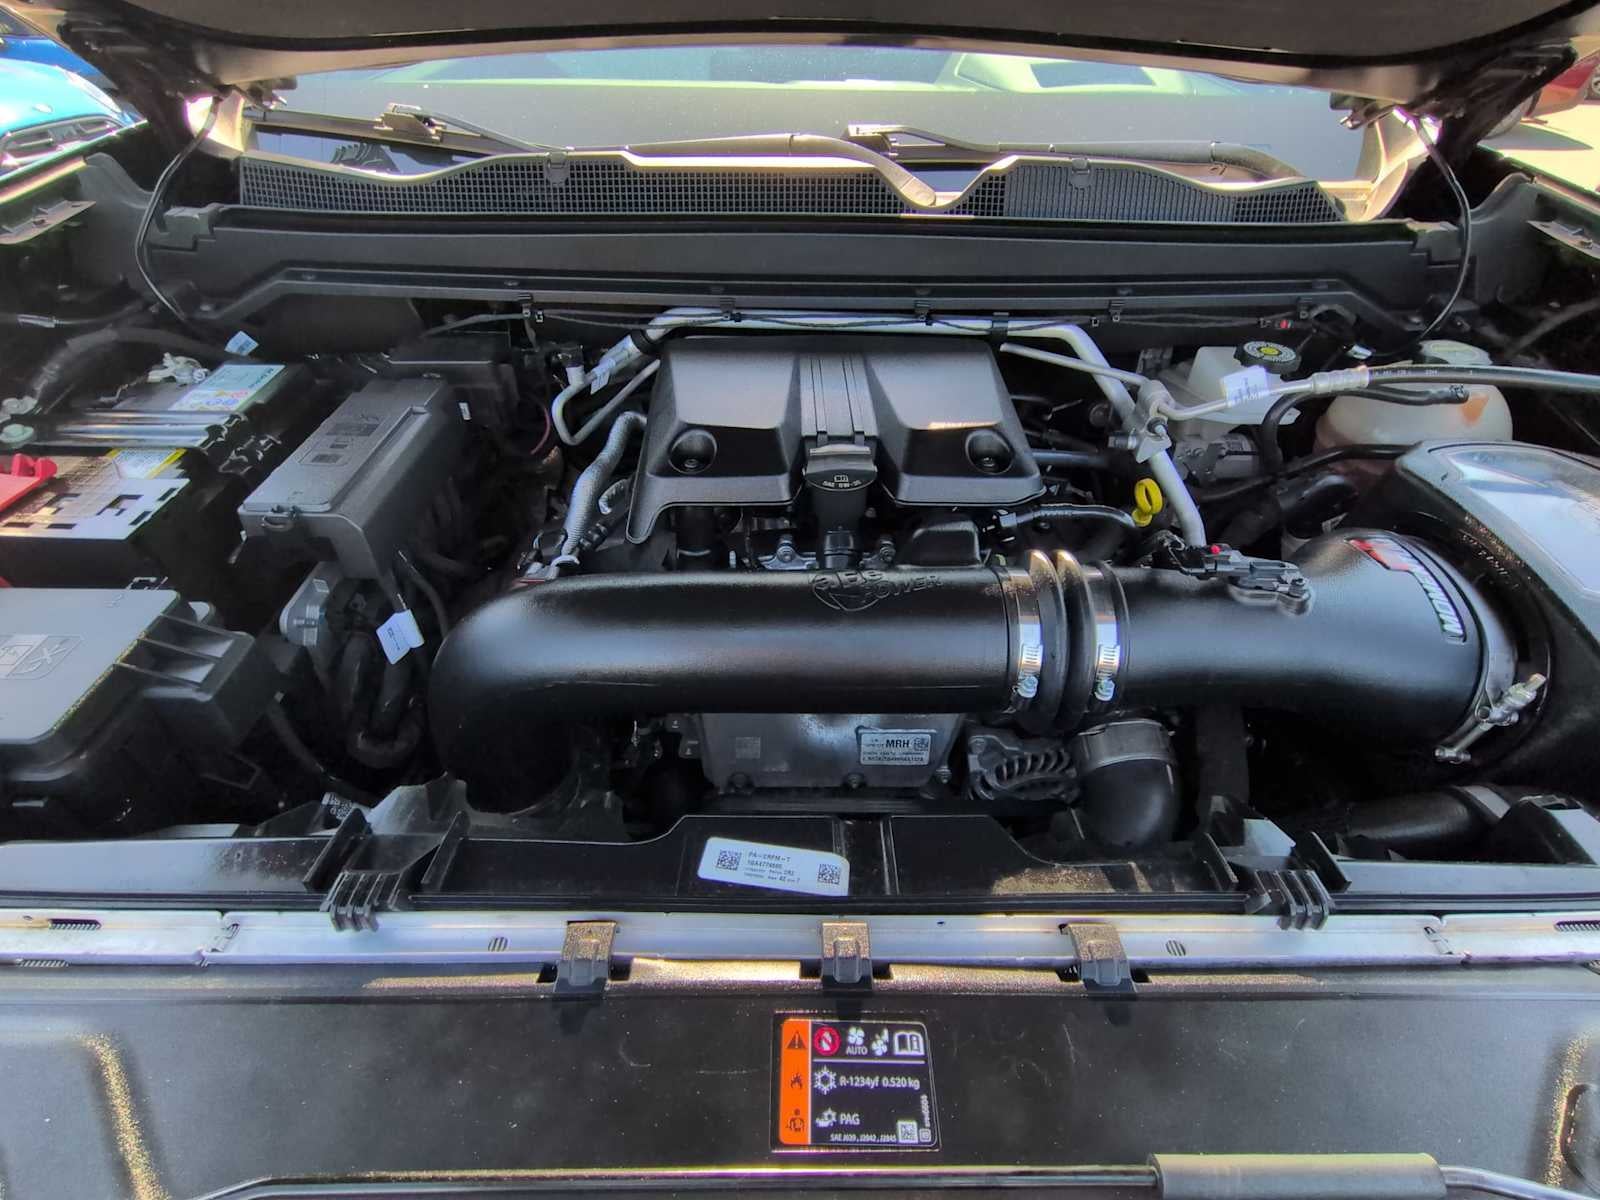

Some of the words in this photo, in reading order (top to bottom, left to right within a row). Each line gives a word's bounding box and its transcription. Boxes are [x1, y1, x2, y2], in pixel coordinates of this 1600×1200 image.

[885, 738, 910, 749] MRH
[846, 1046, 868, 1055] AUTO
[840, 1075, 880, 1089] R-1234yf
[882, 1076, 907, 1088] 0.520
[908, 1077, 920, 1090] kg
[839, 1113, 861, 1125] PAG
